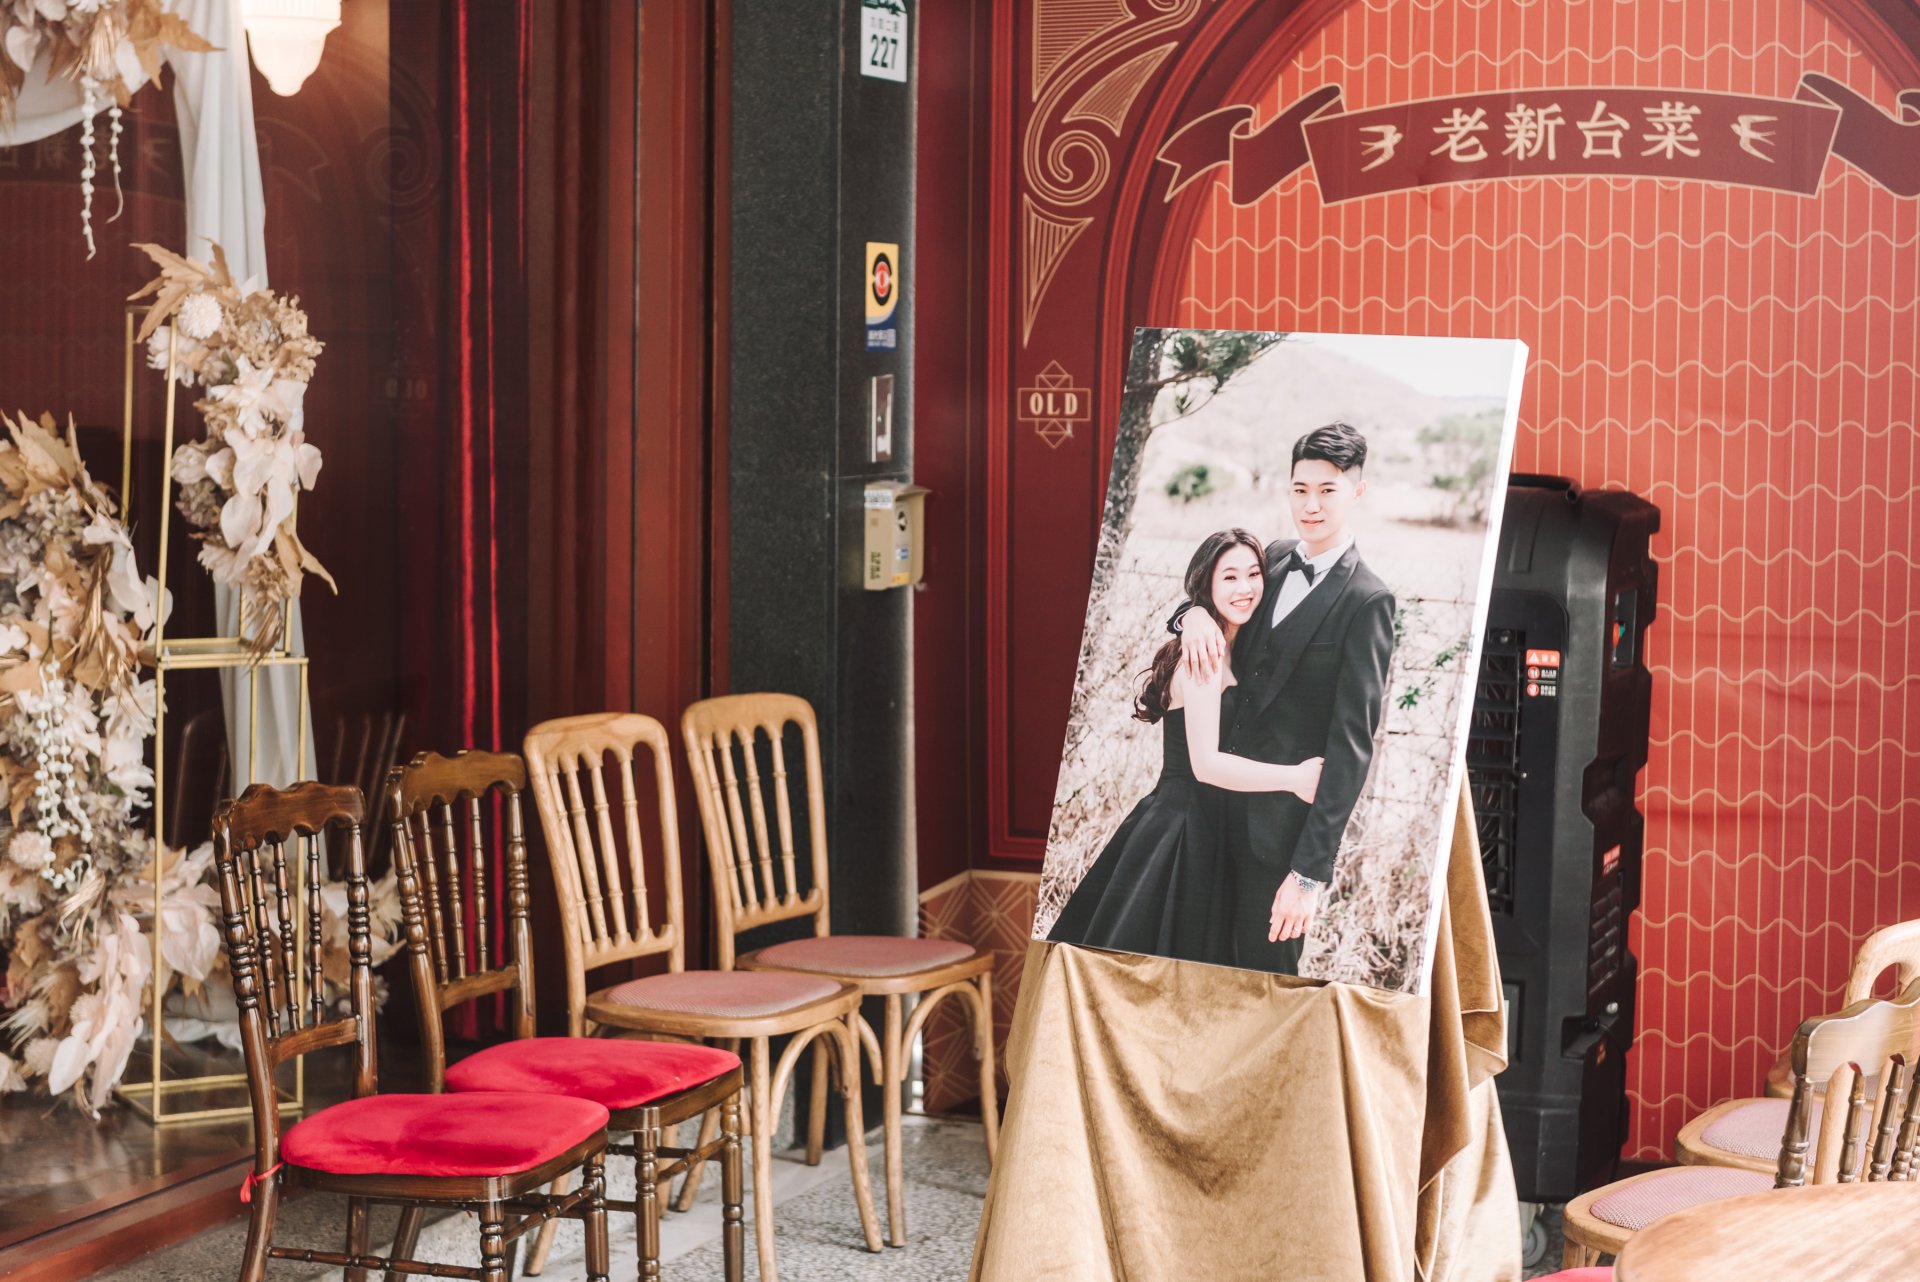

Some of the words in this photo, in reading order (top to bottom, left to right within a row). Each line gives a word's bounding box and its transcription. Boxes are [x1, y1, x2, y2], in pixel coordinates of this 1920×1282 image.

[870, 34, 898, 70] 227
[1430, 101, 1701, 163] 老新台菜
[1029, 392, 1078, 416] OLD
